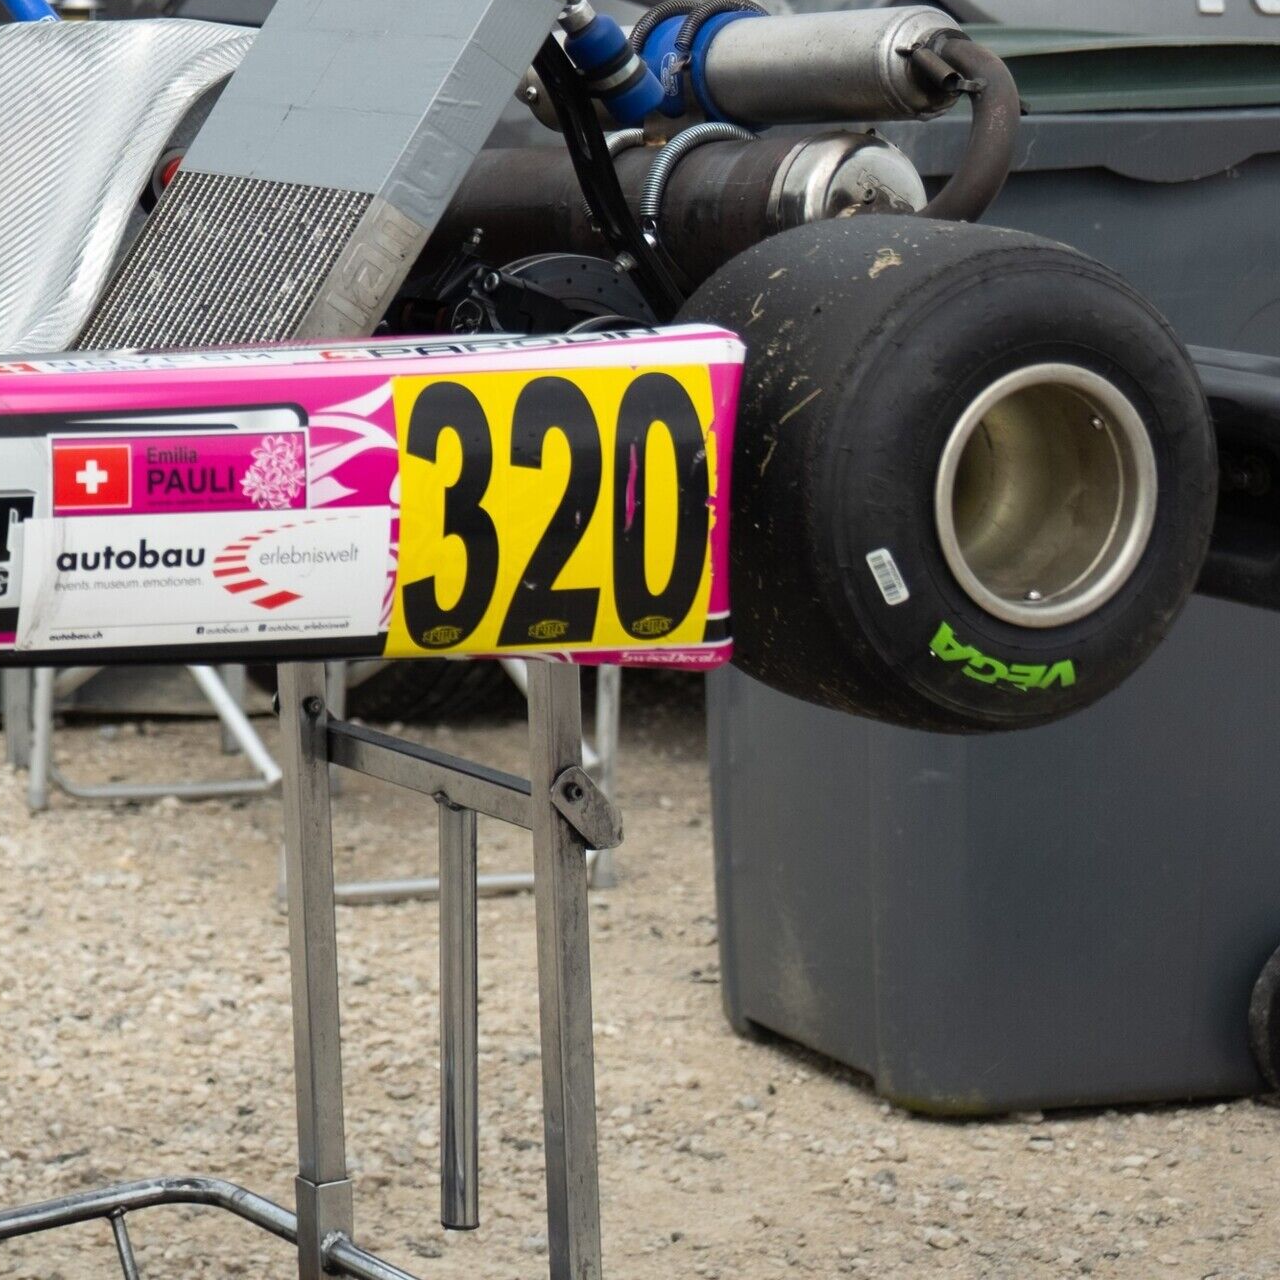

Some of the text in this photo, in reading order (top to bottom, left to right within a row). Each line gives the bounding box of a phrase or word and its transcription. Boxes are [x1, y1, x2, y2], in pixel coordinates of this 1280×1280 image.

[366, 326, 662, 359] PAROLIN
[146, 447, 198, 466] Emilia
[145, 468, 236, 496] PAULI
[400, 371, 711, 650] 320
[56, 539, 205, 572] autobau
[259, 543, 359, 566] erlebniswelt
[49, 631, 103, 642] autobau.ch
[929, 621, 1076, 691] VEGA
